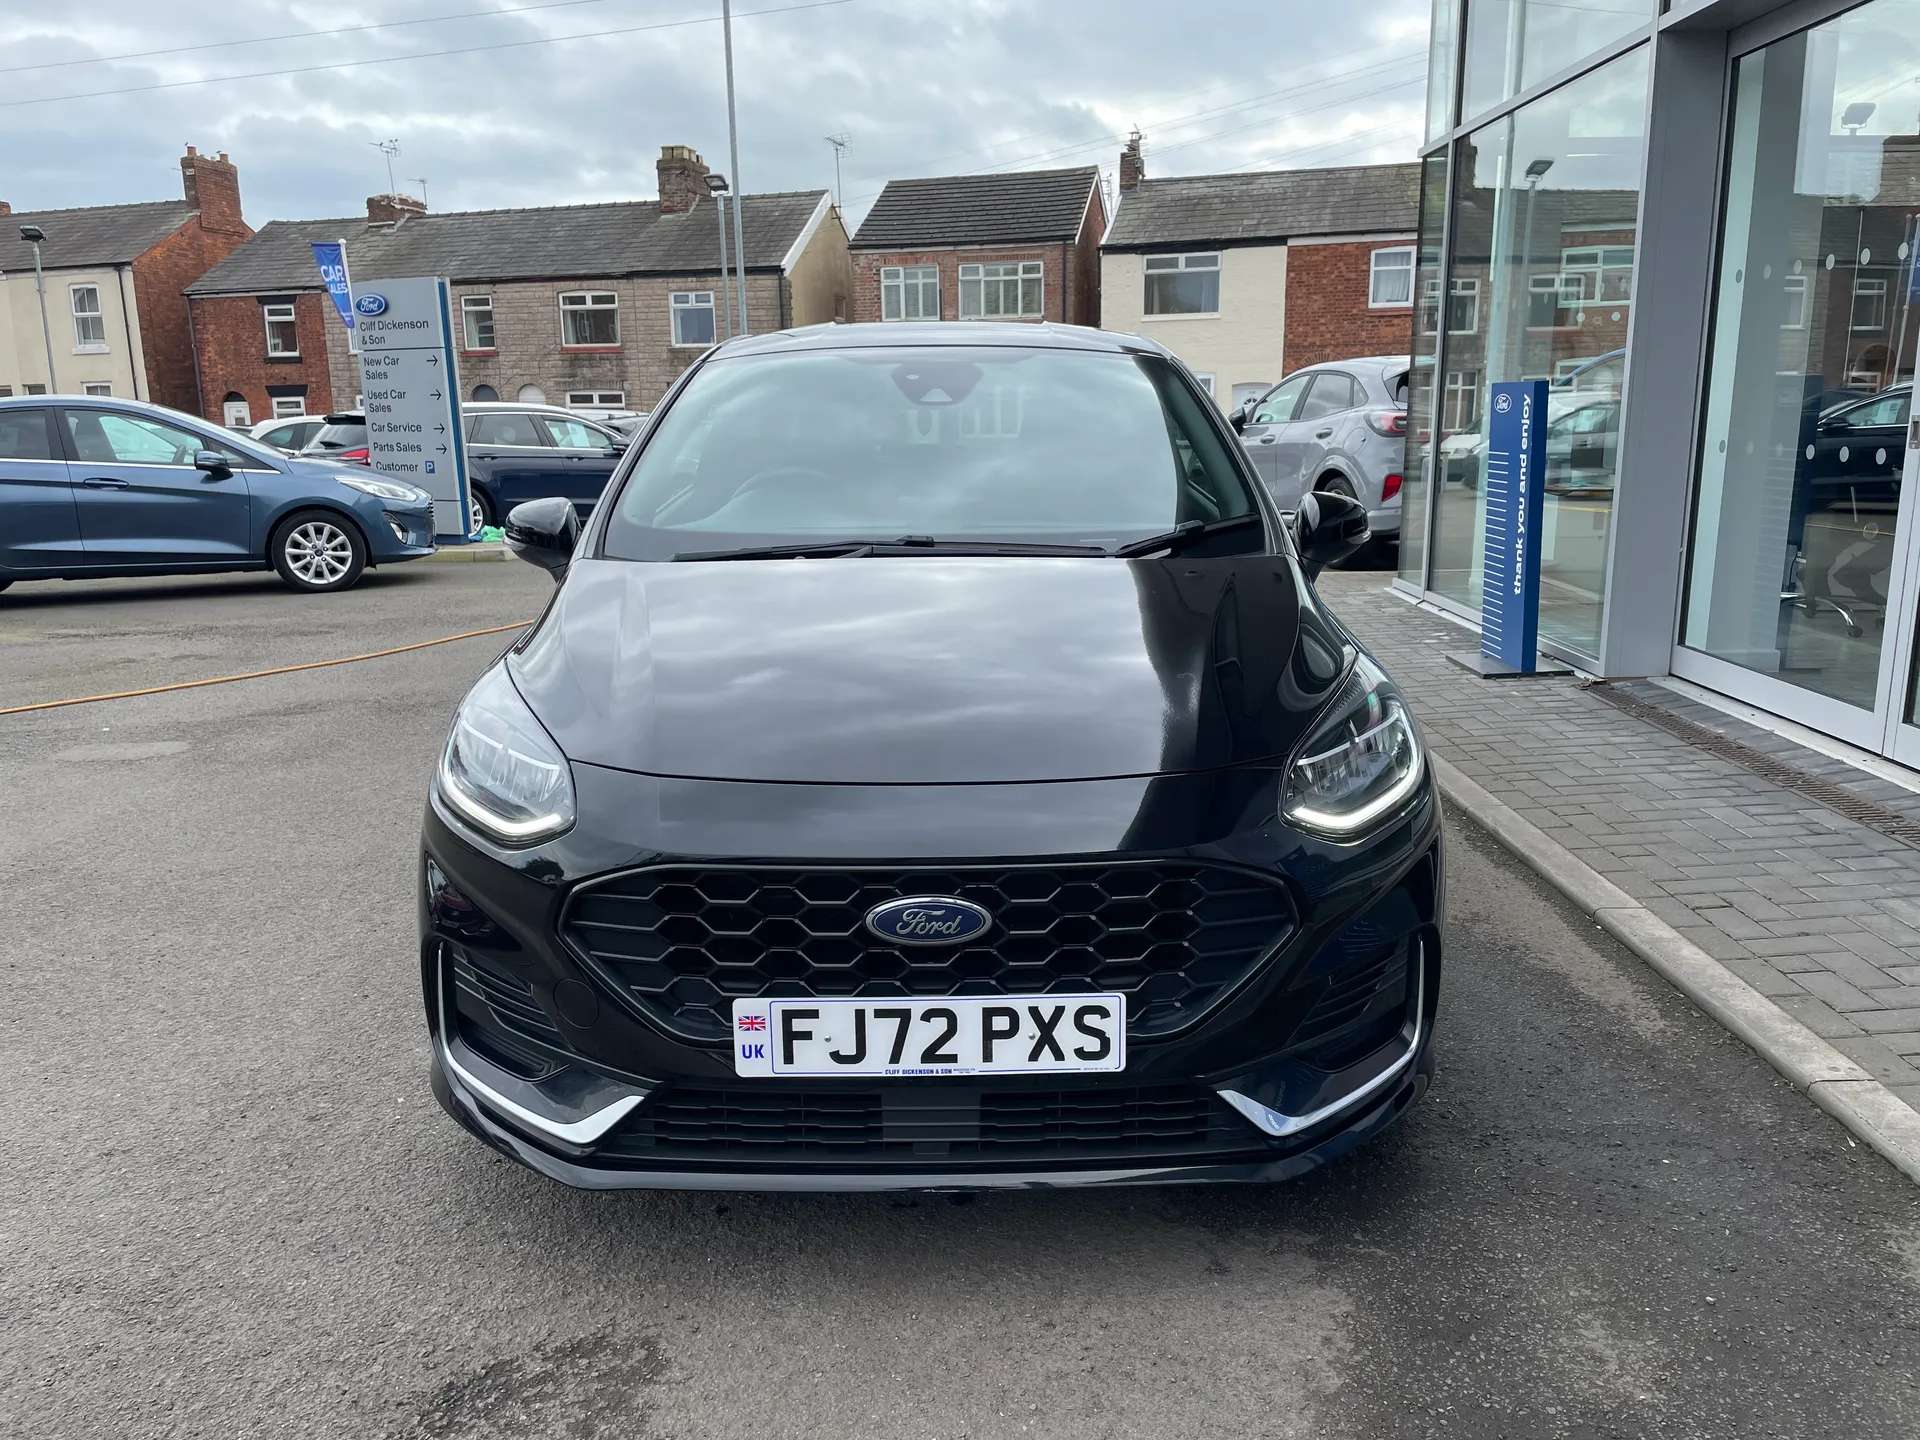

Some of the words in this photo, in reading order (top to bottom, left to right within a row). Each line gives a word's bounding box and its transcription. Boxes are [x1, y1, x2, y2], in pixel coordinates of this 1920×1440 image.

[320, 265, 345, 281] CAR
[360, 297, 379, 312] Ford
[360, 320, 376, 332] Cliff
[377, 319, 429, 331] Dickenson
[361, 335, 368, 345] &
[368, 334, 386, 345] Son
[363, 356, 382, 367] New
[383, 355, 400, 366] Car
[365, 369, 389, 380] Sales
[367, 389, 389, 400] Used
[389, 388, 407, 400] Car
[368, 402, 392, 413] Sales
[371, 422, 385, 433] Car
[386, 421, 422, 433] Service
[1521, 393, 1532, 450] enjoy
[373, 441, 395, 452] Parts
[395, 441, 422, 453] Sales
[375, 461, 419, 472] Customer
[1519, 453, 1528, 494] and
[1517, 496, 1525, 534] you
[1513, 537, 1524, 595] thank
[895, 908, 962, 935] Ford
[781, 1008, 958, 1065] FJ72
[982, 1005, 1111, 1063] PXS
[741, 1044, 764, 1059] UK
